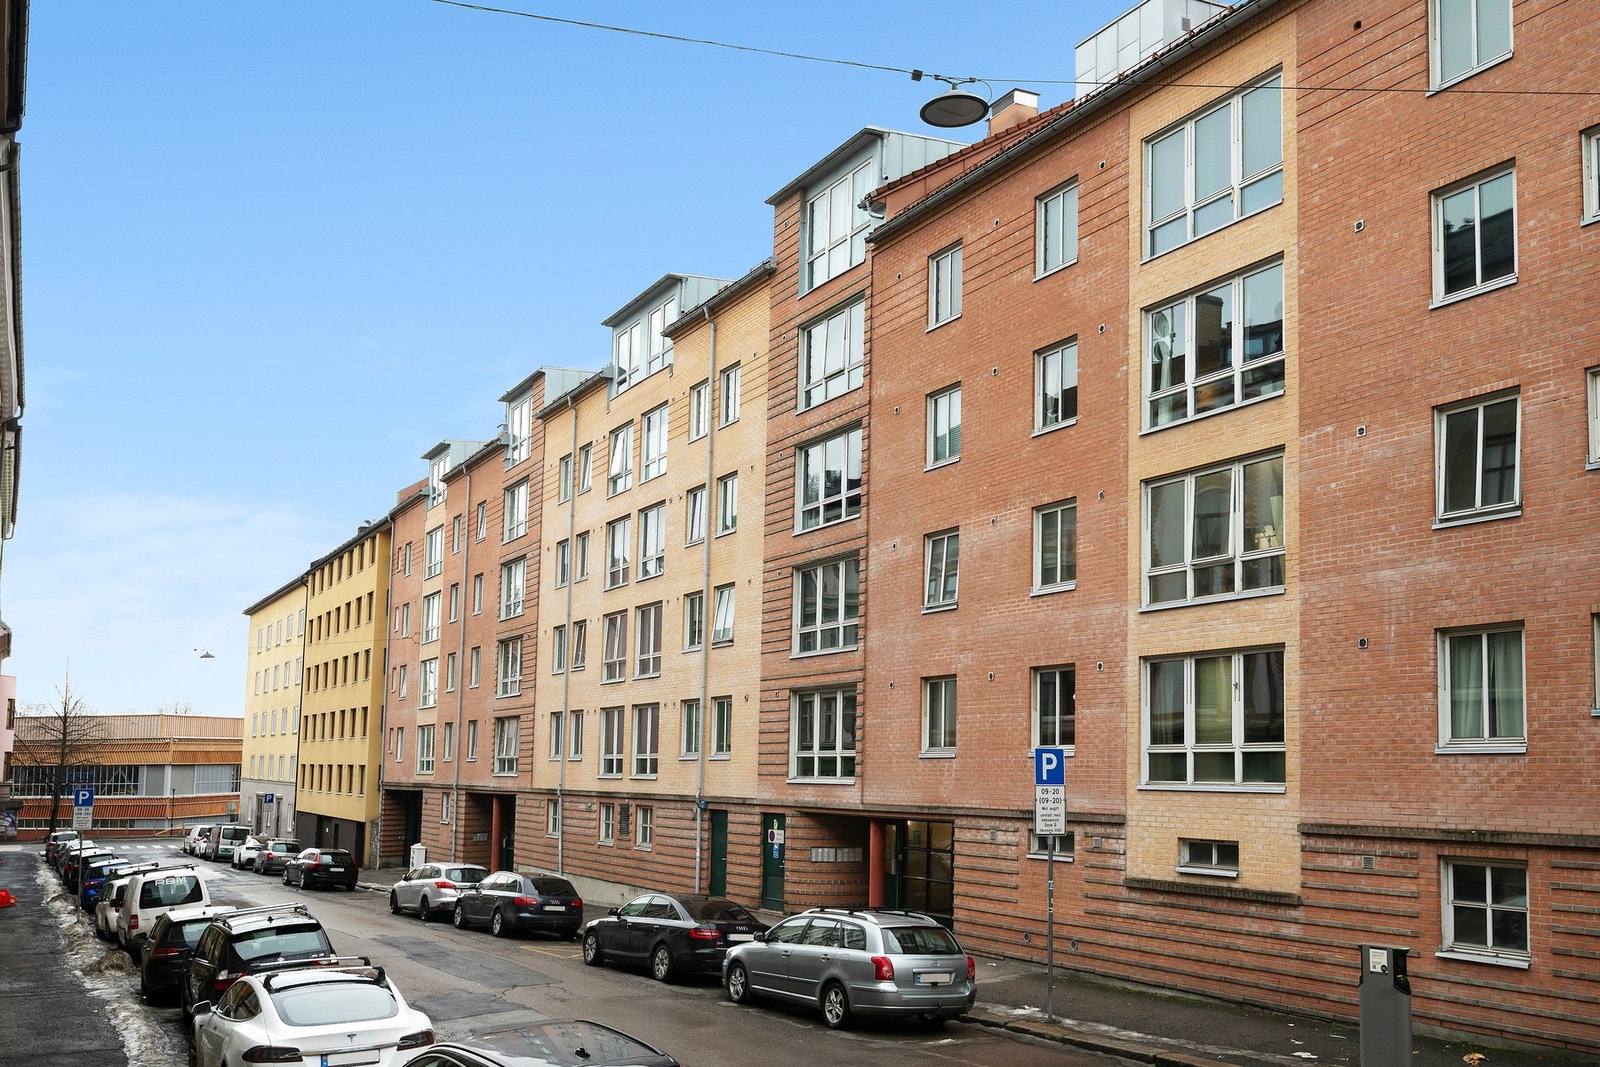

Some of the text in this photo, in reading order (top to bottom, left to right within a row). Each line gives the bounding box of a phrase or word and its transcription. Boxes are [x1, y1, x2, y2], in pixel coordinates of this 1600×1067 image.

[1042, 753, 1057, 780] P
[78, 791, 90, 804] P
[1039, 797, 1062, 805] (09-20)
[155, 876, 186, 886] RBM
